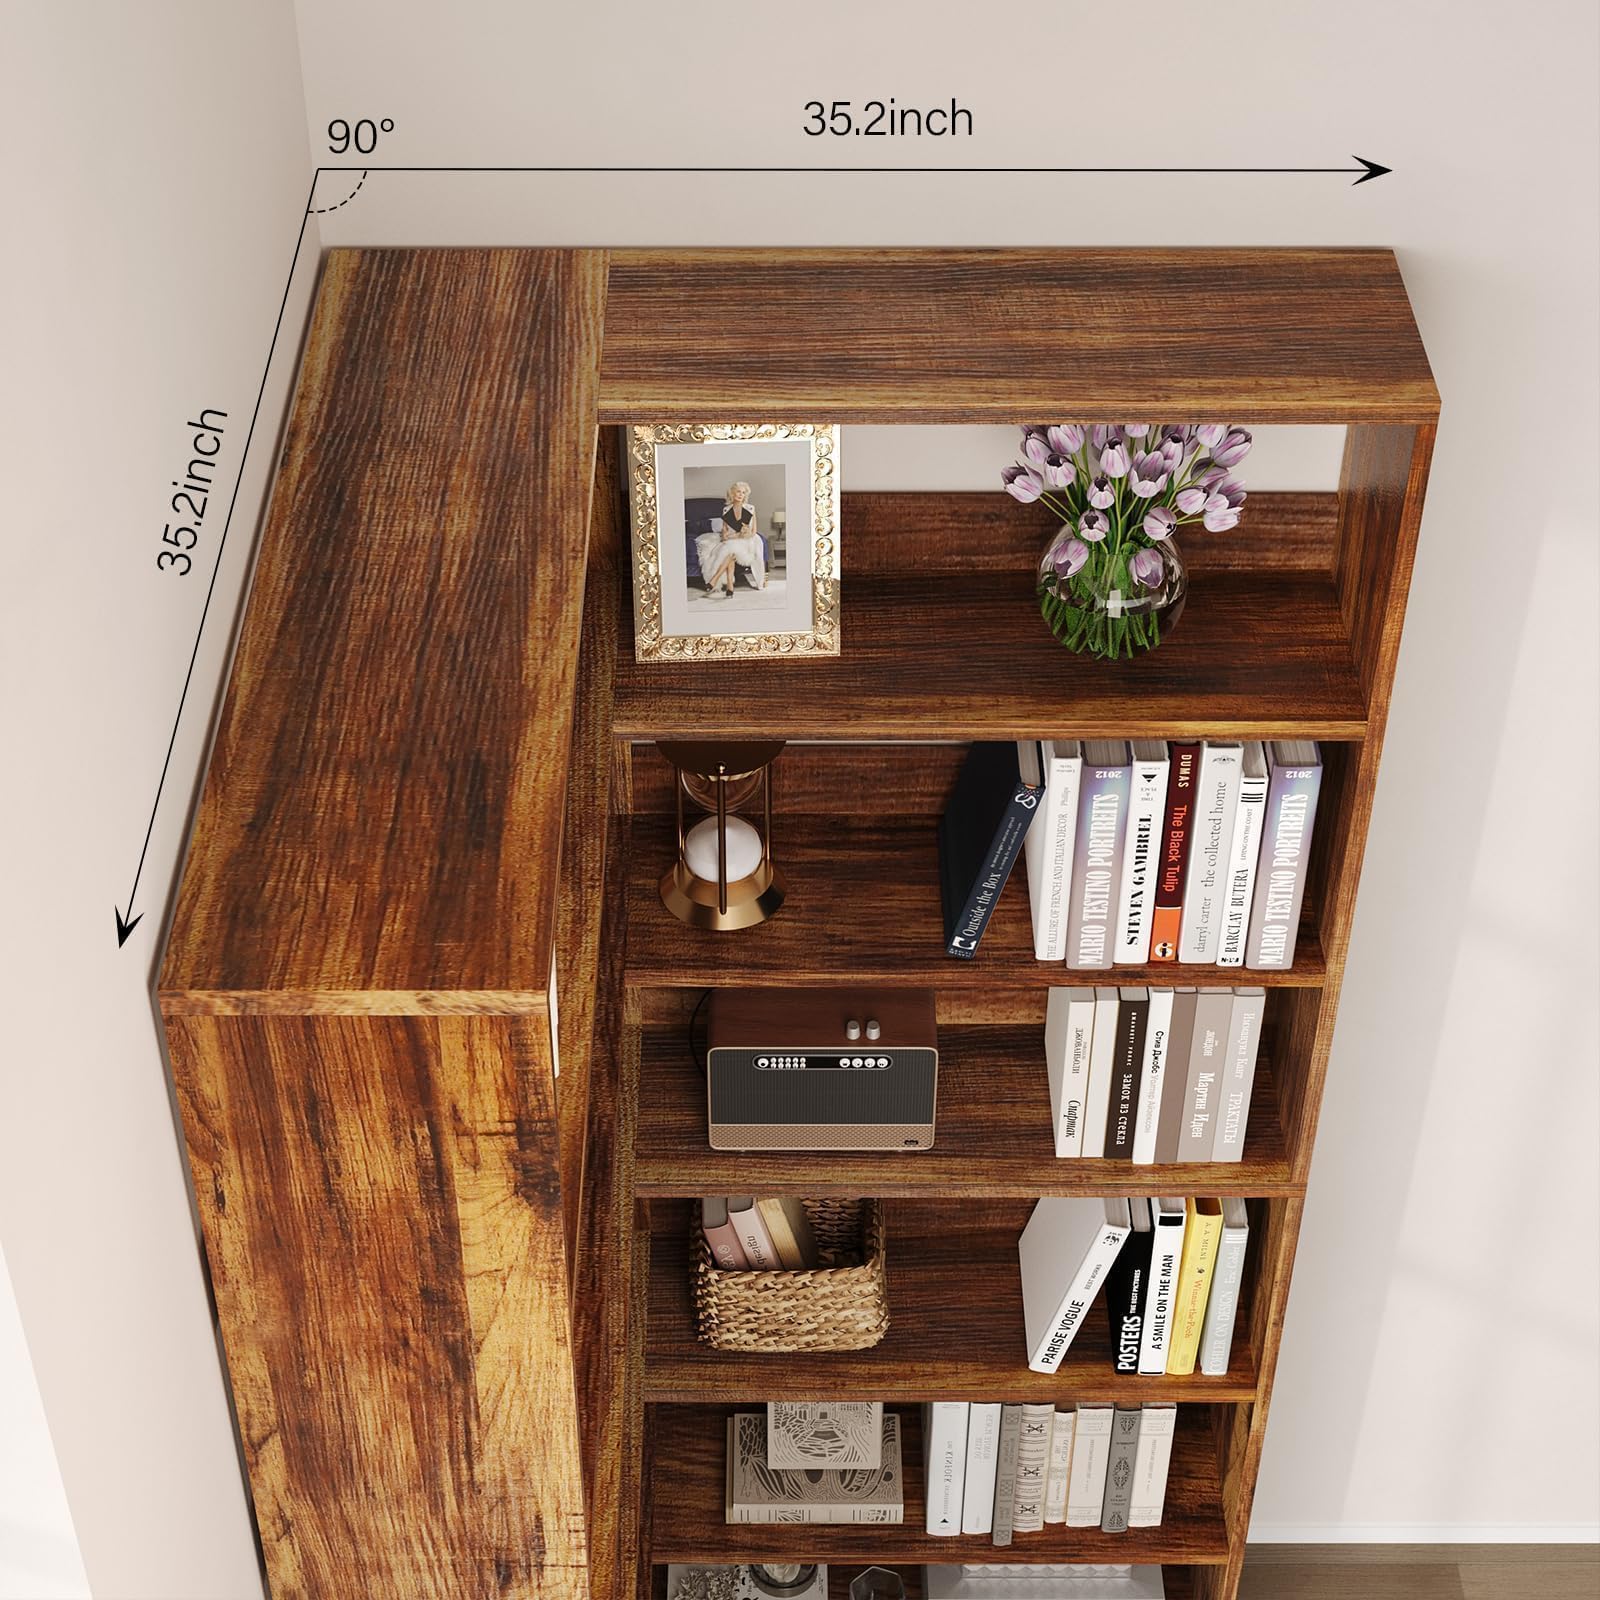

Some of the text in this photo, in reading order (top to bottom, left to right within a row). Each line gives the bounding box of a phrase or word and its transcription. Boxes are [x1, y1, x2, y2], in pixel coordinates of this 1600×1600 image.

[1095, 770, 1123, 779] 2012
[1178, 754, 1193, 789] DUMAS
[1285, 770, 1313, 779] 2012
[1056, 813, 1068, 838] DECOR
[1162, 804, 1188, 892] The Black Tulip
[1201, 781, 1227, 888] the collected home
[962, 872, 1002, 937] Outside the Box
[1082, 870, 1112, 921] TESTINO
[1127, 814, 1153, 945] STEVEN GAMBREL
[1231, 868, 1249, 907] BUTERA
[1265, 870, 1298, 921] TESTINO
[1078, 925, 1106, 965] MARIO
[1193, 896, 1212, 953] darryl carter
[1225, 911, 1243, 953] BARCLAY
[1258, 925, 1288, 965] MARIO
[1151, 1031, 1165, 1074] Стив Джобс
[1064, 1100, 1081, 1138] Спартак
[1190, 1072, 1215, 1138] Мартин Иден
[1223, 1092, 1244, 1144] ТРАКТАТЫ
[1151, 1254, 1174, 1350] A SMILE ON THE MAN
[1217, 1291, 1233, 1320] DESIGN
[1041, 1300, 1085, 1365] PARISE VOGUE
[1117, 1315, 1141, 1371] POSTERS
